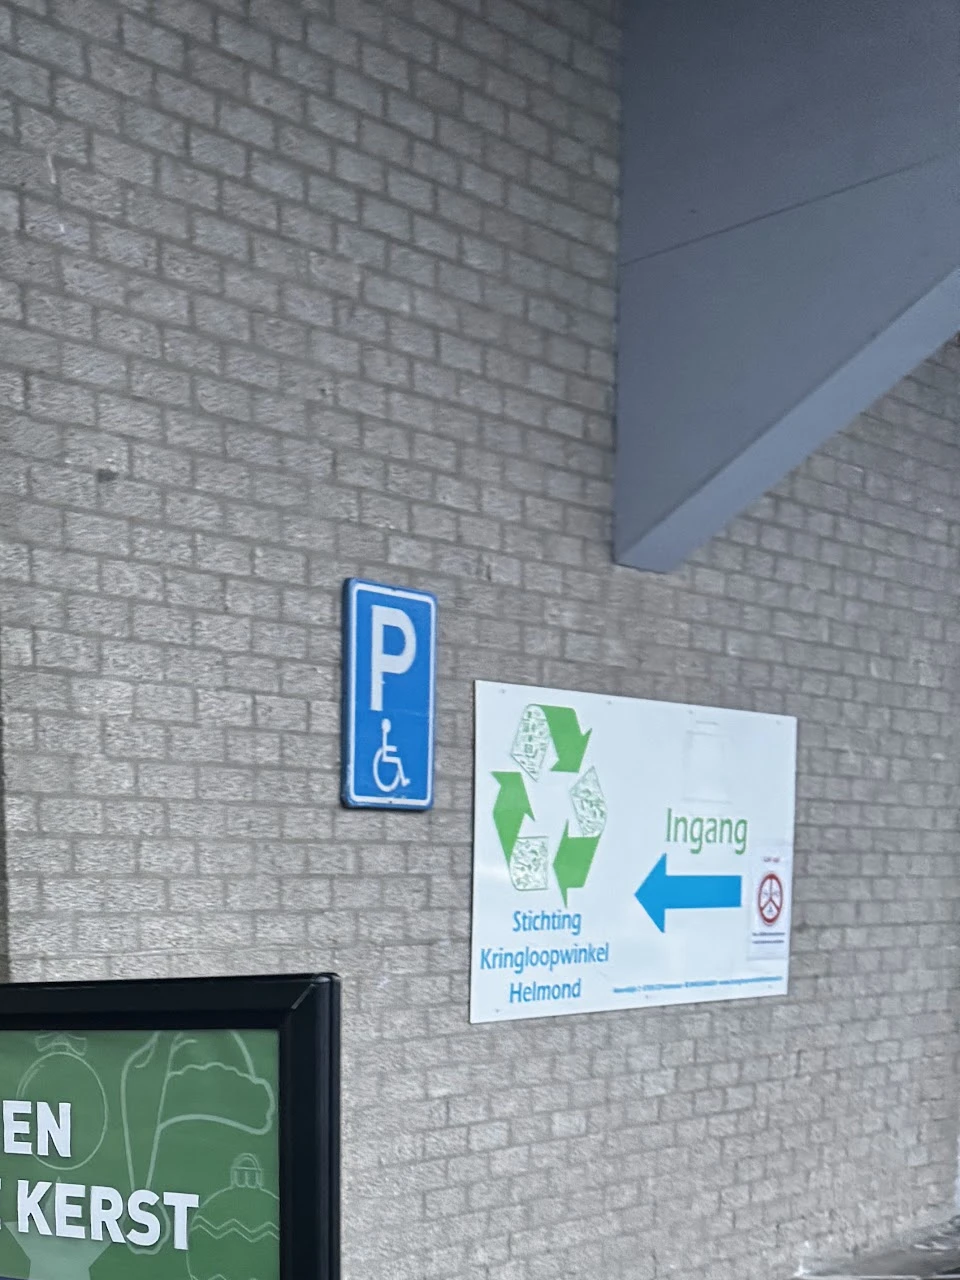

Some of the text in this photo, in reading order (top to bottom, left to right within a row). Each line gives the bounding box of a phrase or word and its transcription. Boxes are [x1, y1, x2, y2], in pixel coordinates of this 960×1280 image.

[370, 604, 416, 712] P
[666, 808, 749, 855] Ingang
[512, 910, 582, 936] Stichting
[480, 942, 610, 974] Kringloopwinkel
[509, 978, 582, 1003] Helmond
[16, 1180, 201, 1252] KERST
